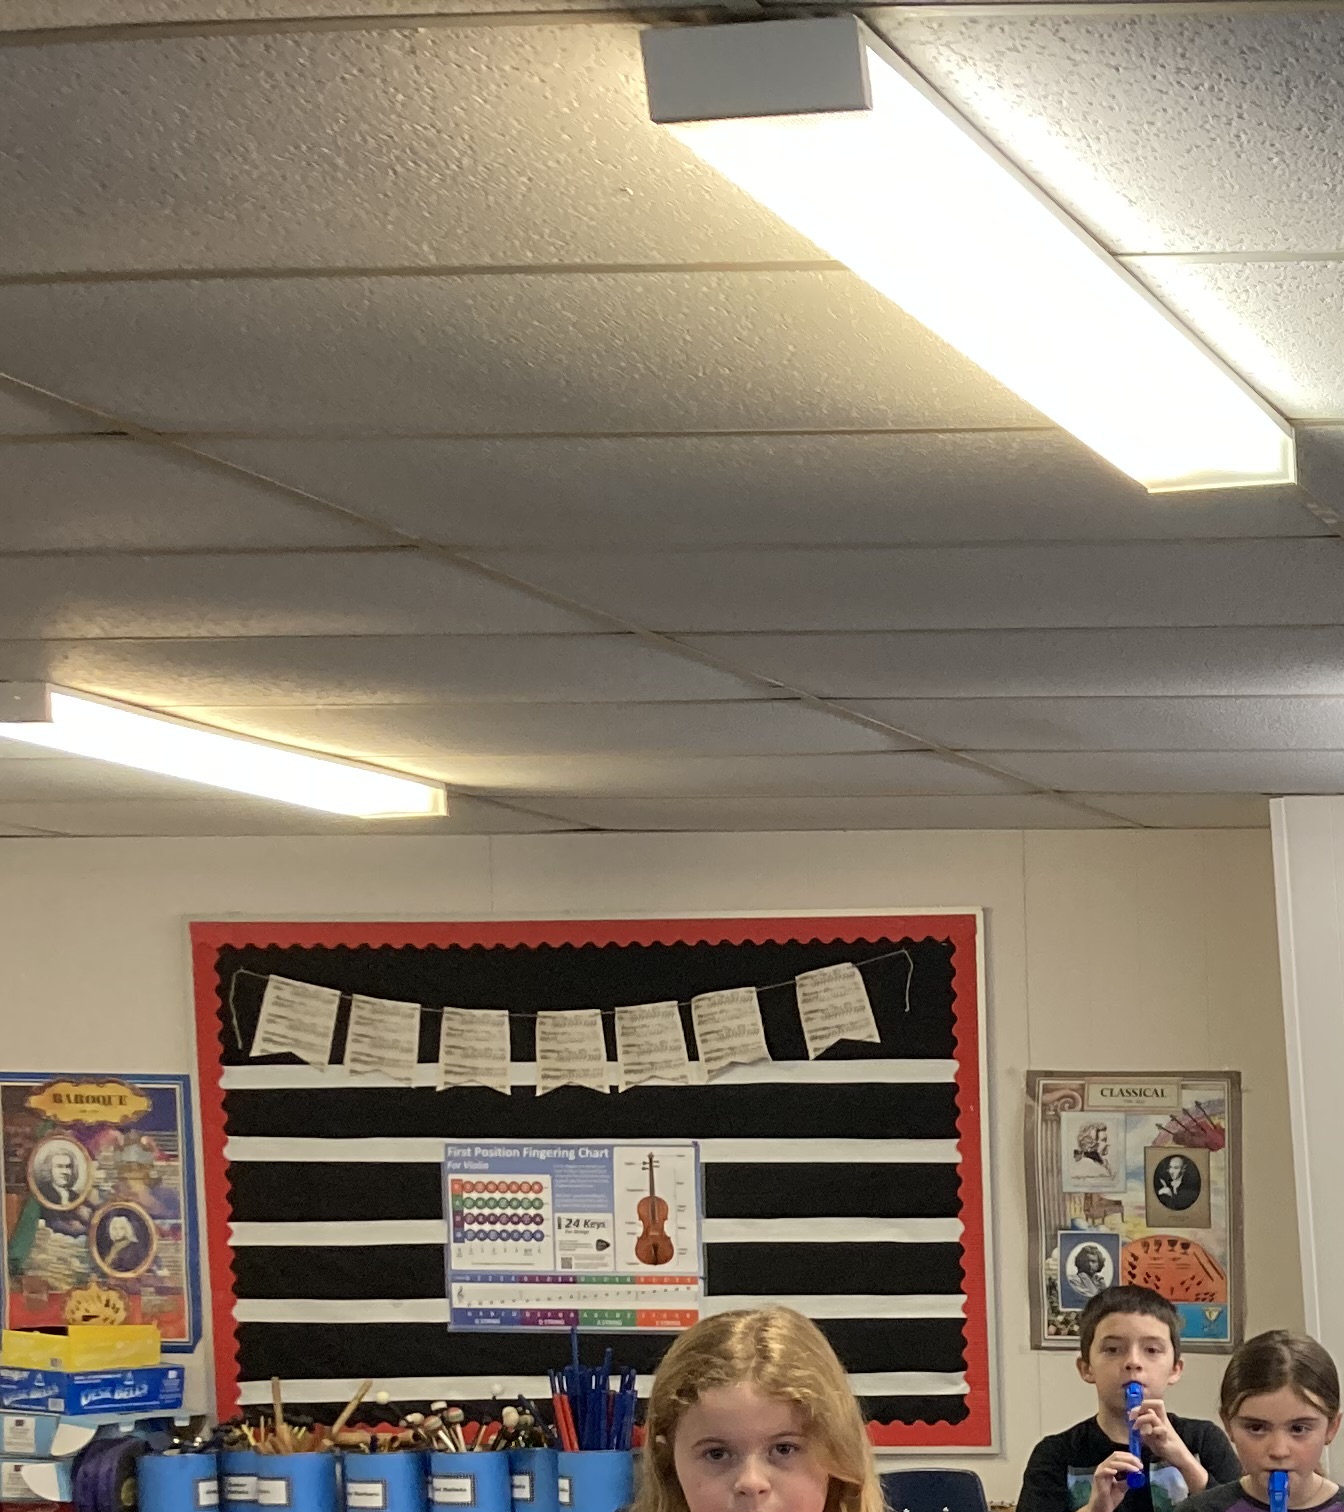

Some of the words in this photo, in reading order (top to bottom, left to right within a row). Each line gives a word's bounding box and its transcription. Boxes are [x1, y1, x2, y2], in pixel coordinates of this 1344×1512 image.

[1100, 1086, 1167, 1099] CLASSICAL
[51, 1092, 129, 1107] BAROQUE
[447, 1146, 471, 1158] First
[474, 1147, 520, 1158] Position
[523, 1147, 576, 1161] Fingering
[578, 1148, 609, 1158] Chart
[447, 1161, 461, 1170] For
[464, 1161, 489, 1170] Violin
[564, 1218, 580, 1228] 24
[583, 1219, 606, 1230] Keys
